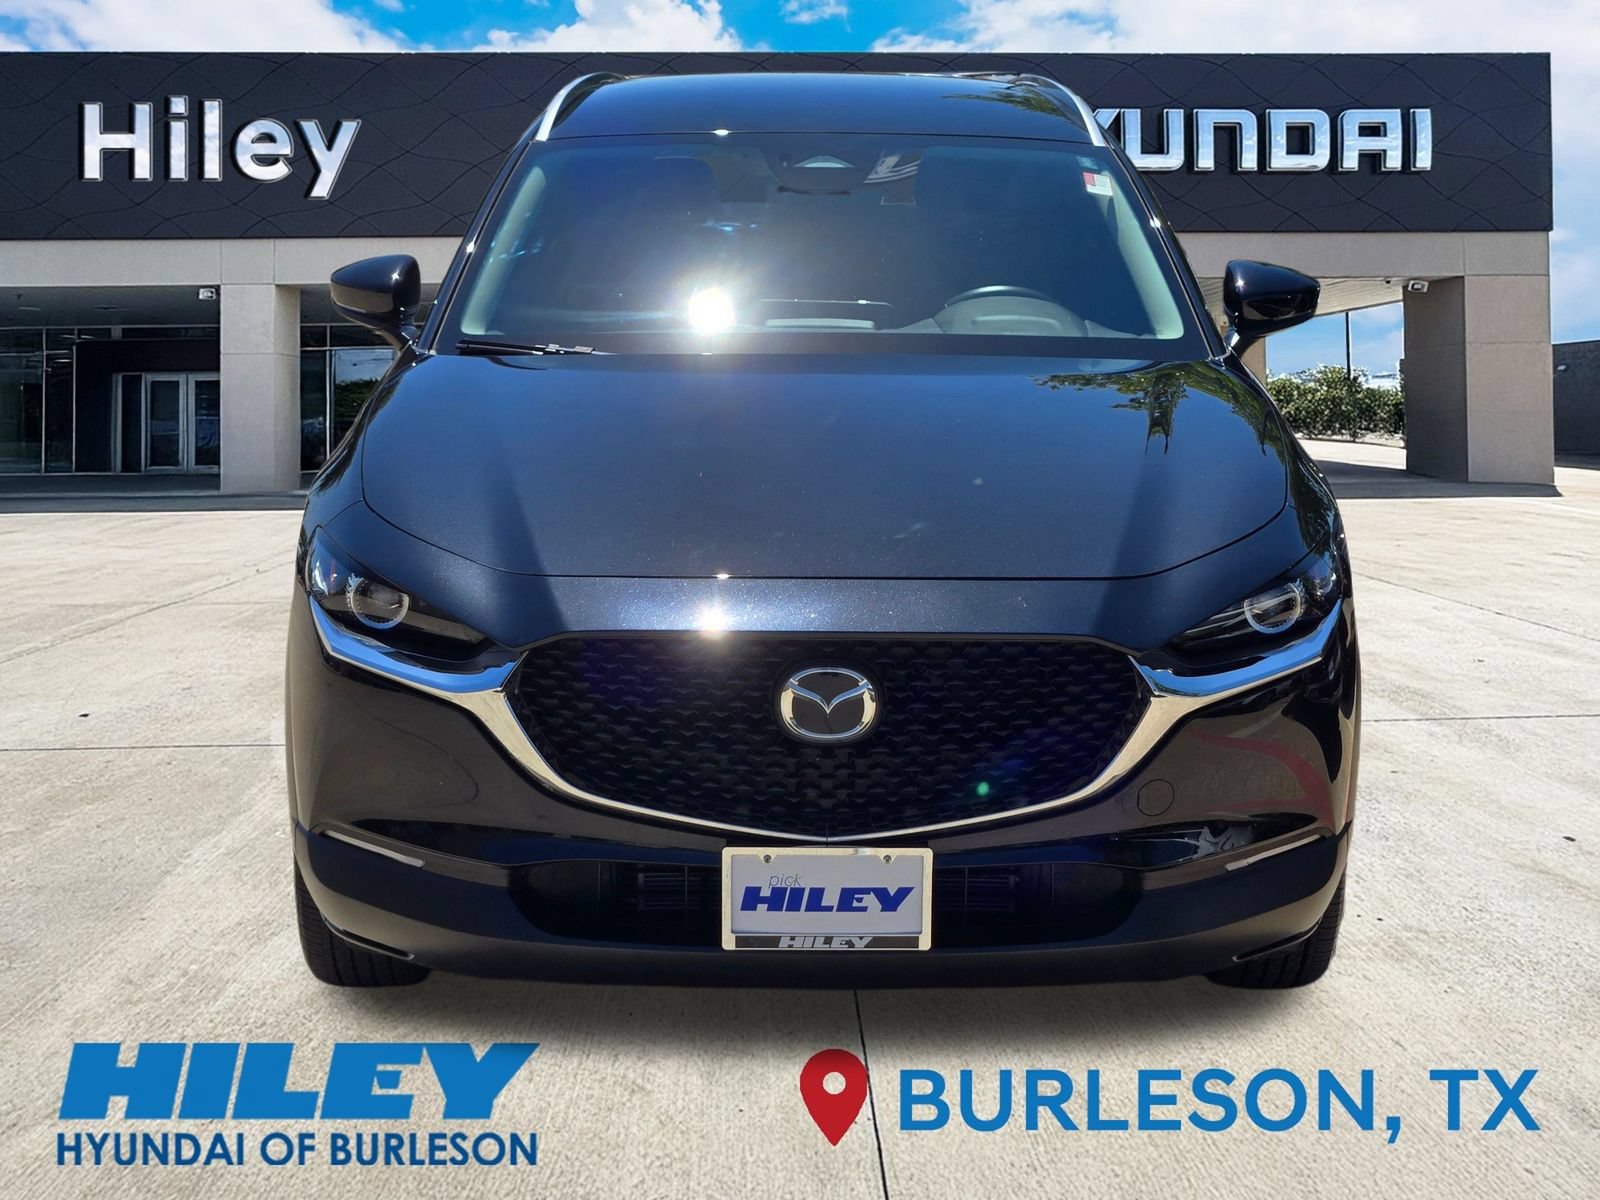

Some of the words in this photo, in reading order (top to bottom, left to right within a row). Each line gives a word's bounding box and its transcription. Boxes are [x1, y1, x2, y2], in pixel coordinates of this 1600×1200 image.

[80, 95, 361, 200] Hiley
[768, 873, 801, 888] pick
[740, 886, 915, 912] HILEY
[778, 936, 873, 948] HILEY
